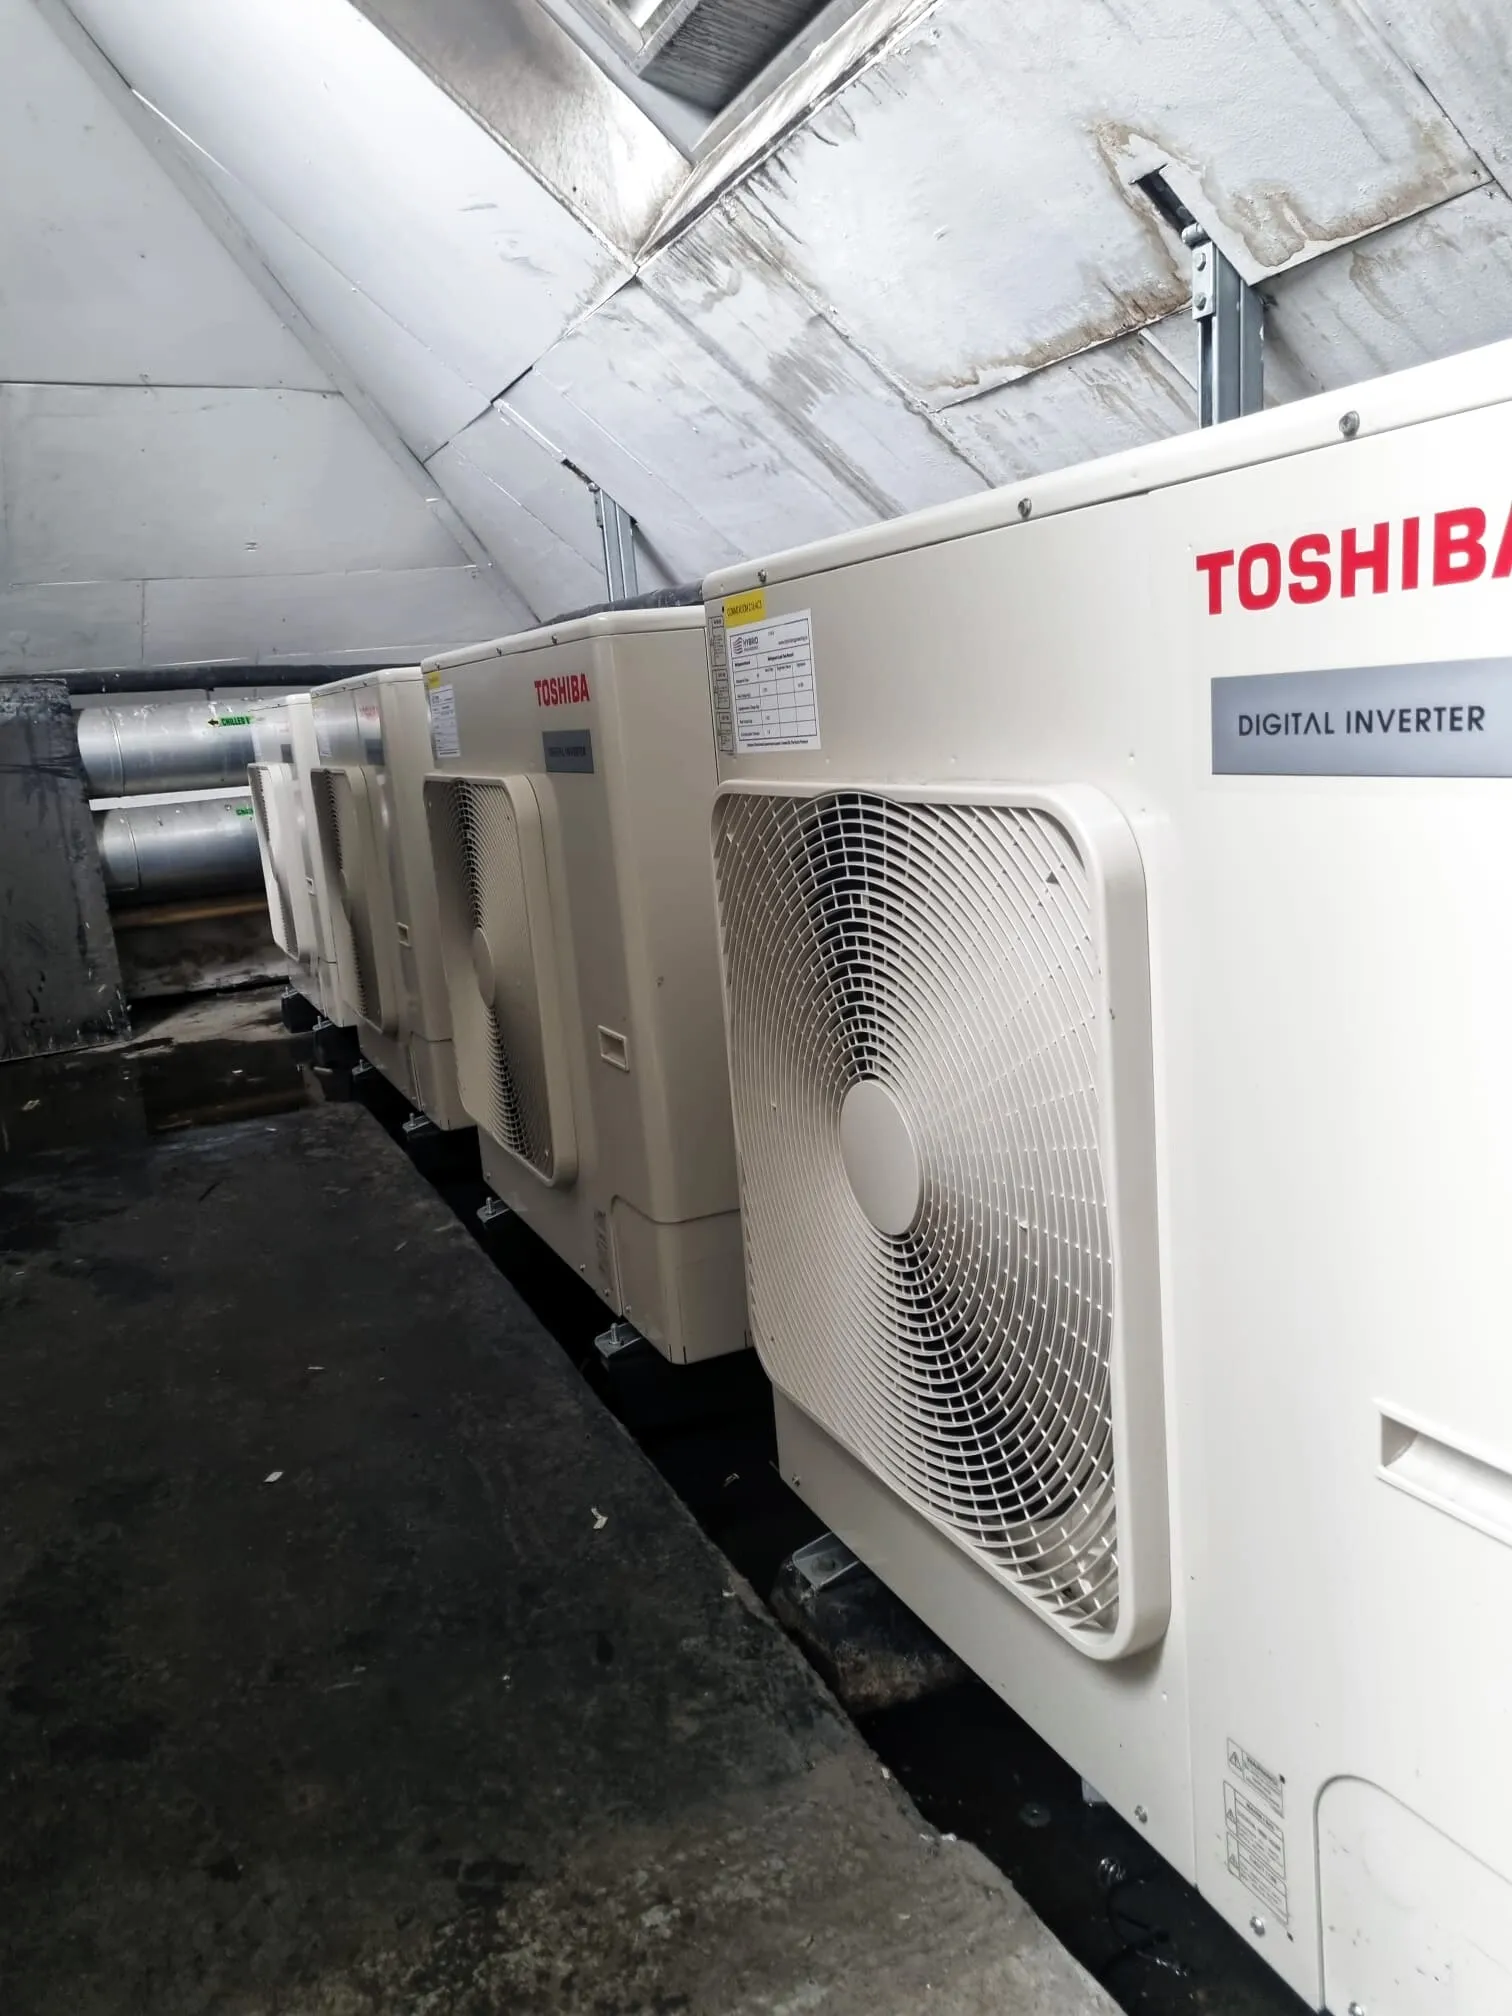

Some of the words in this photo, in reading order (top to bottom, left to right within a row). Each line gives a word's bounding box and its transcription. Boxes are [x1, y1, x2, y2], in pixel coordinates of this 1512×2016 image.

[534, 672, 590, 707] TOSHIBA
[1238, 711, 1334, 736] DIGITAL
[1346, 705, 1485, 734] INVERTER
